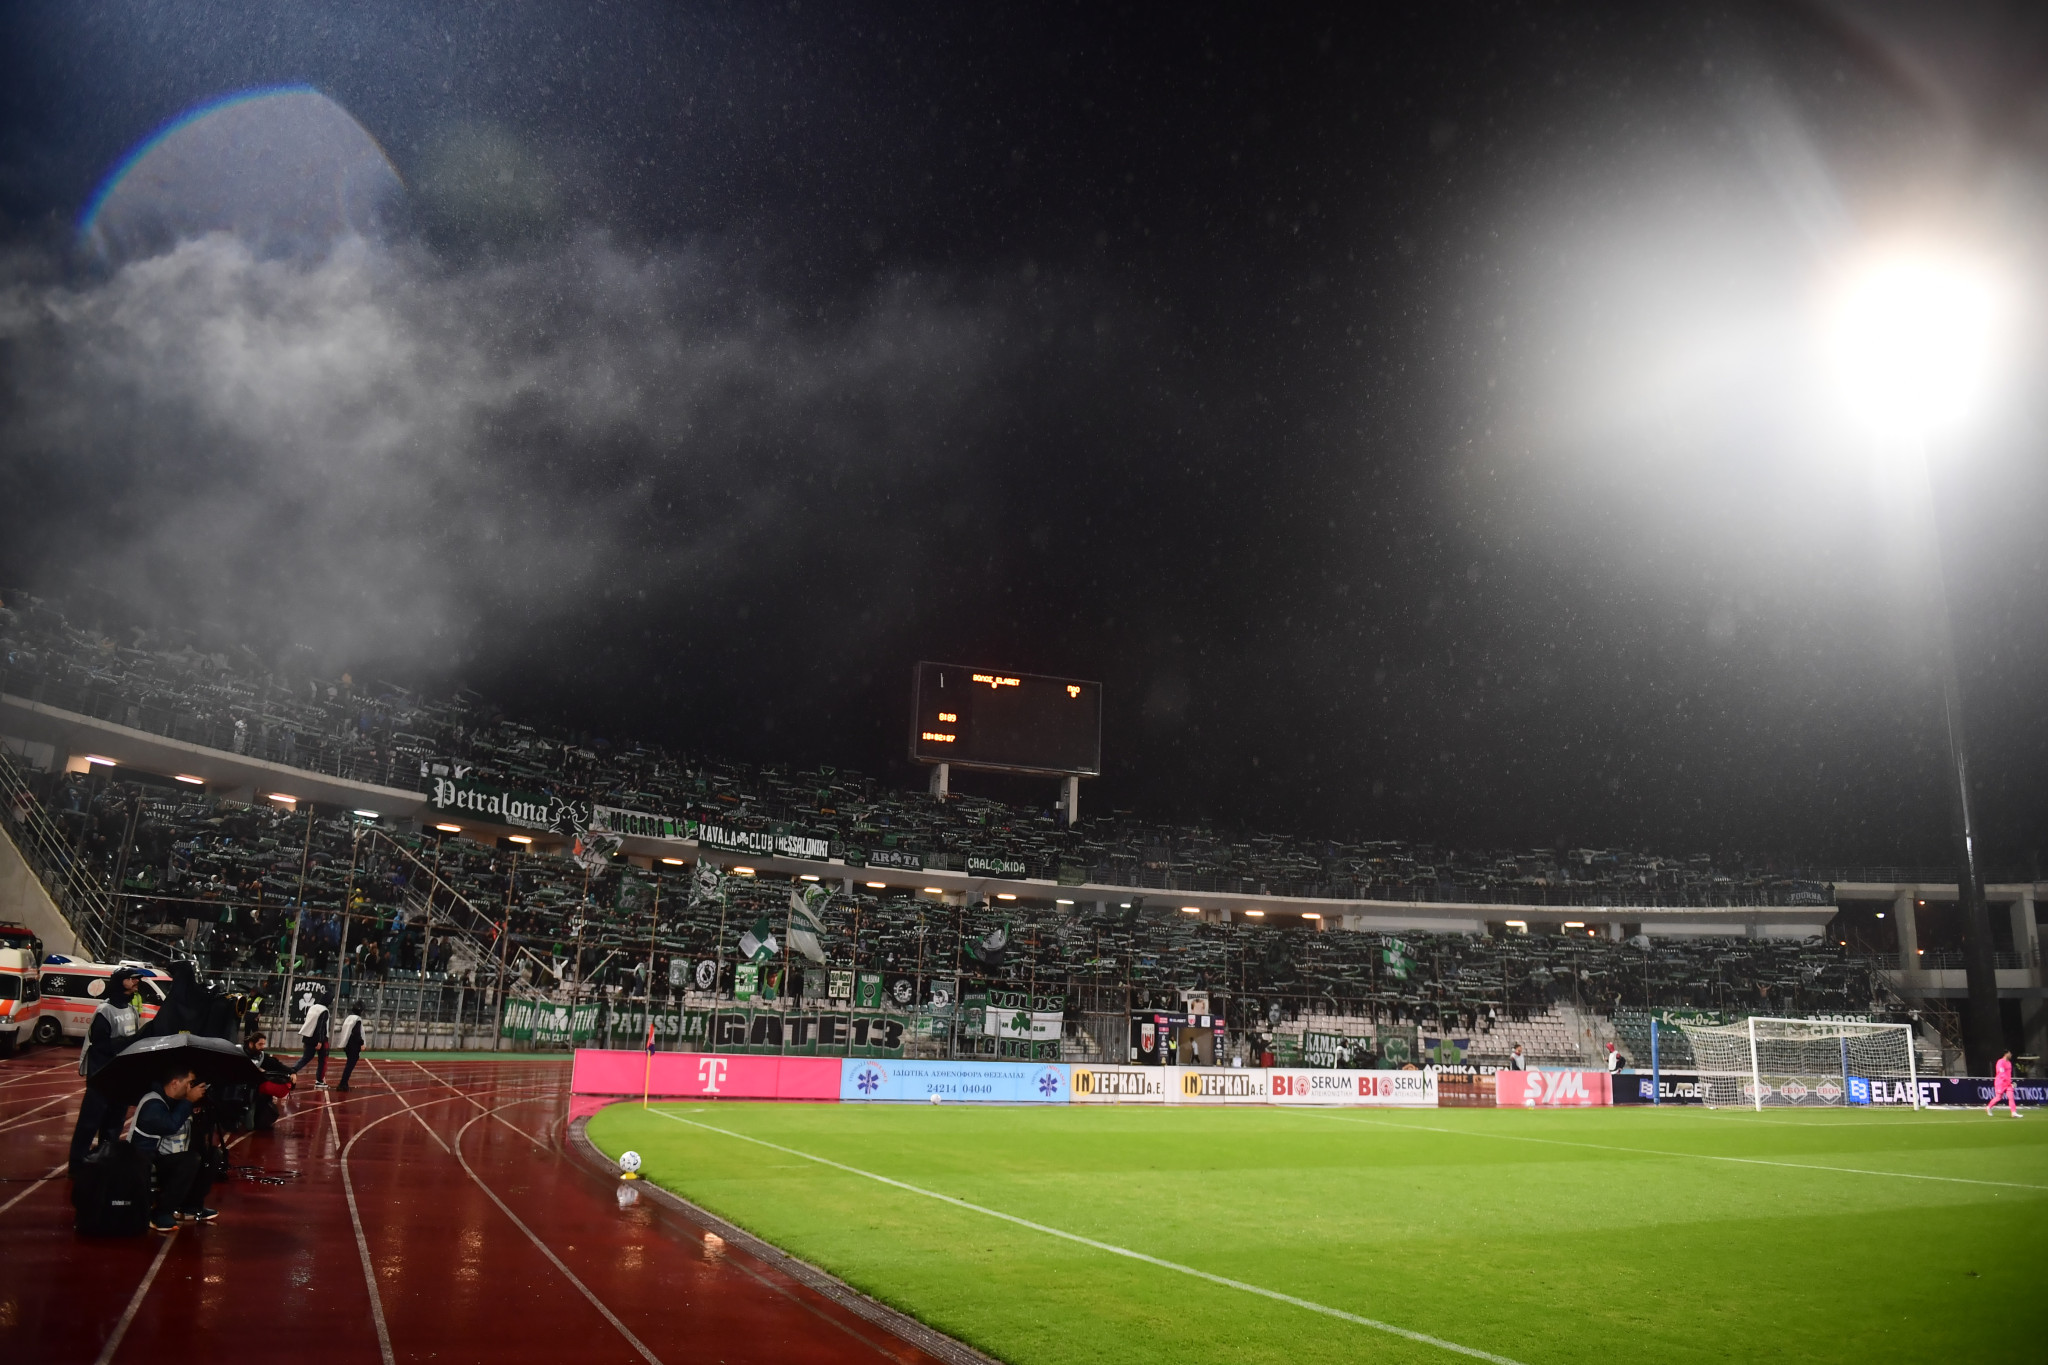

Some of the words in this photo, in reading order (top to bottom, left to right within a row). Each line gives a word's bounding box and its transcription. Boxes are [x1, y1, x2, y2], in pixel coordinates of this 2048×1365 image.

[432, 777, 549, 823] Petralona
[611, 812, 666, 838] MEGARA
[699, 823, 737, 846] KAVALA
[749, 832, 773, 852] CLUB
[989, 989, 1064, 1011] VOLOS
[114, 1015, 125, 1023] TV
[984, 1038, 1030, 1059] GATE
[1036, 1042, 1058, 1059] 13
[931, 1070, 982, 1078] ΑΣΘΕΝΟΦΟΡΑ
[926, 1083, 957, 1093] 24214
[962, 1084, 992, 1094] 04040
[1524, 1071, 1590, 1103] SYM
[1871, 1081, 1941, 1102] ELABET
